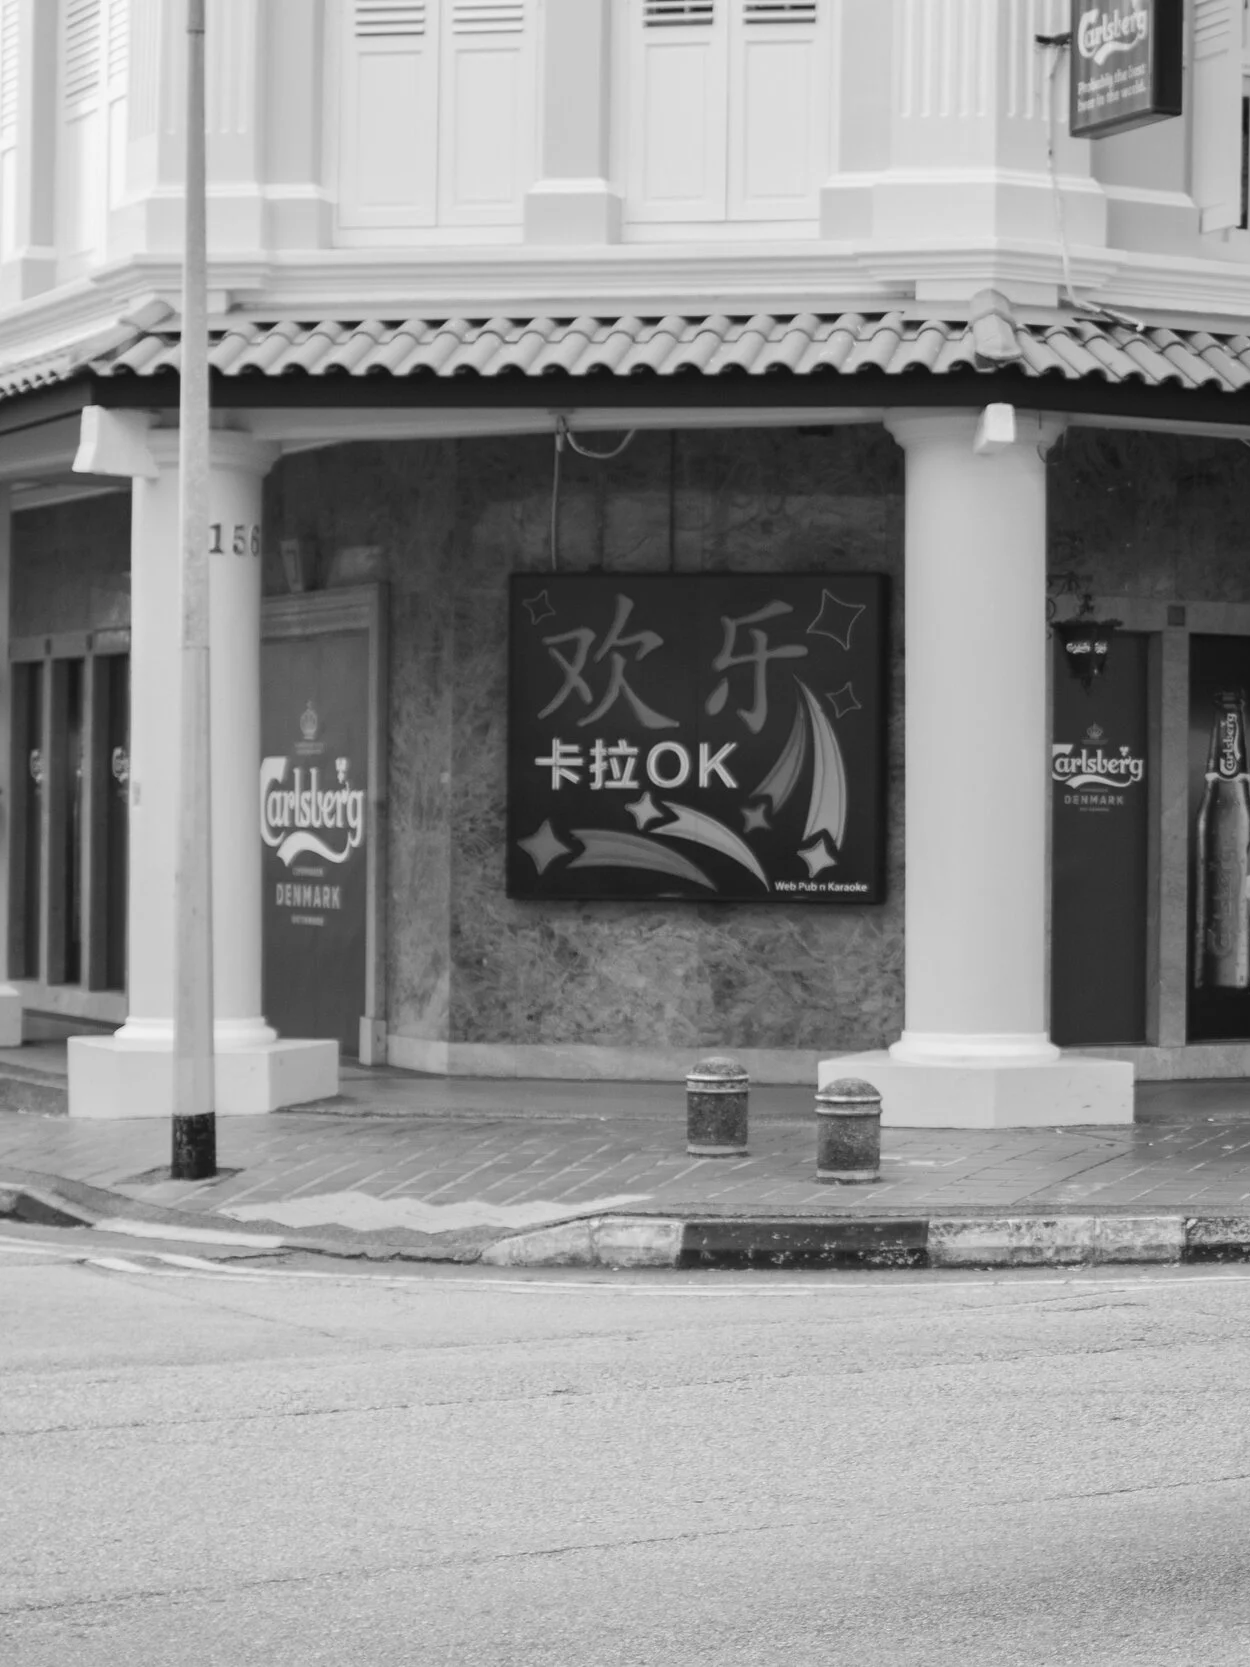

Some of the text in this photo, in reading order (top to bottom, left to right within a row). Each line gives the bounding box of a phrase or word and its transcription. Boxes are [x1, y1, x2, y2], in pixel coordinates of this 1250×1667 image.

[1078, 9, 1147, 58] Carlsberg
[208, 523, 260, 557] 156
[537, 594, 808, 734] 欢乐
[534, 737, 739, 790] 卡拉OK
[1052, 744, 1144, 782] Carlsberg
[1219, 713, 1238, 776] Carlsberg
[260, 756, 365, 848] Carlsberg
[1064, 795, 1124, 805] DENMARK
[275, 883, 341, 909] DENMARK
[775, 881, 797, 891] Web
[799, 882, 817, 891] Pub
[828, 881, 868, 891] Karaoke
